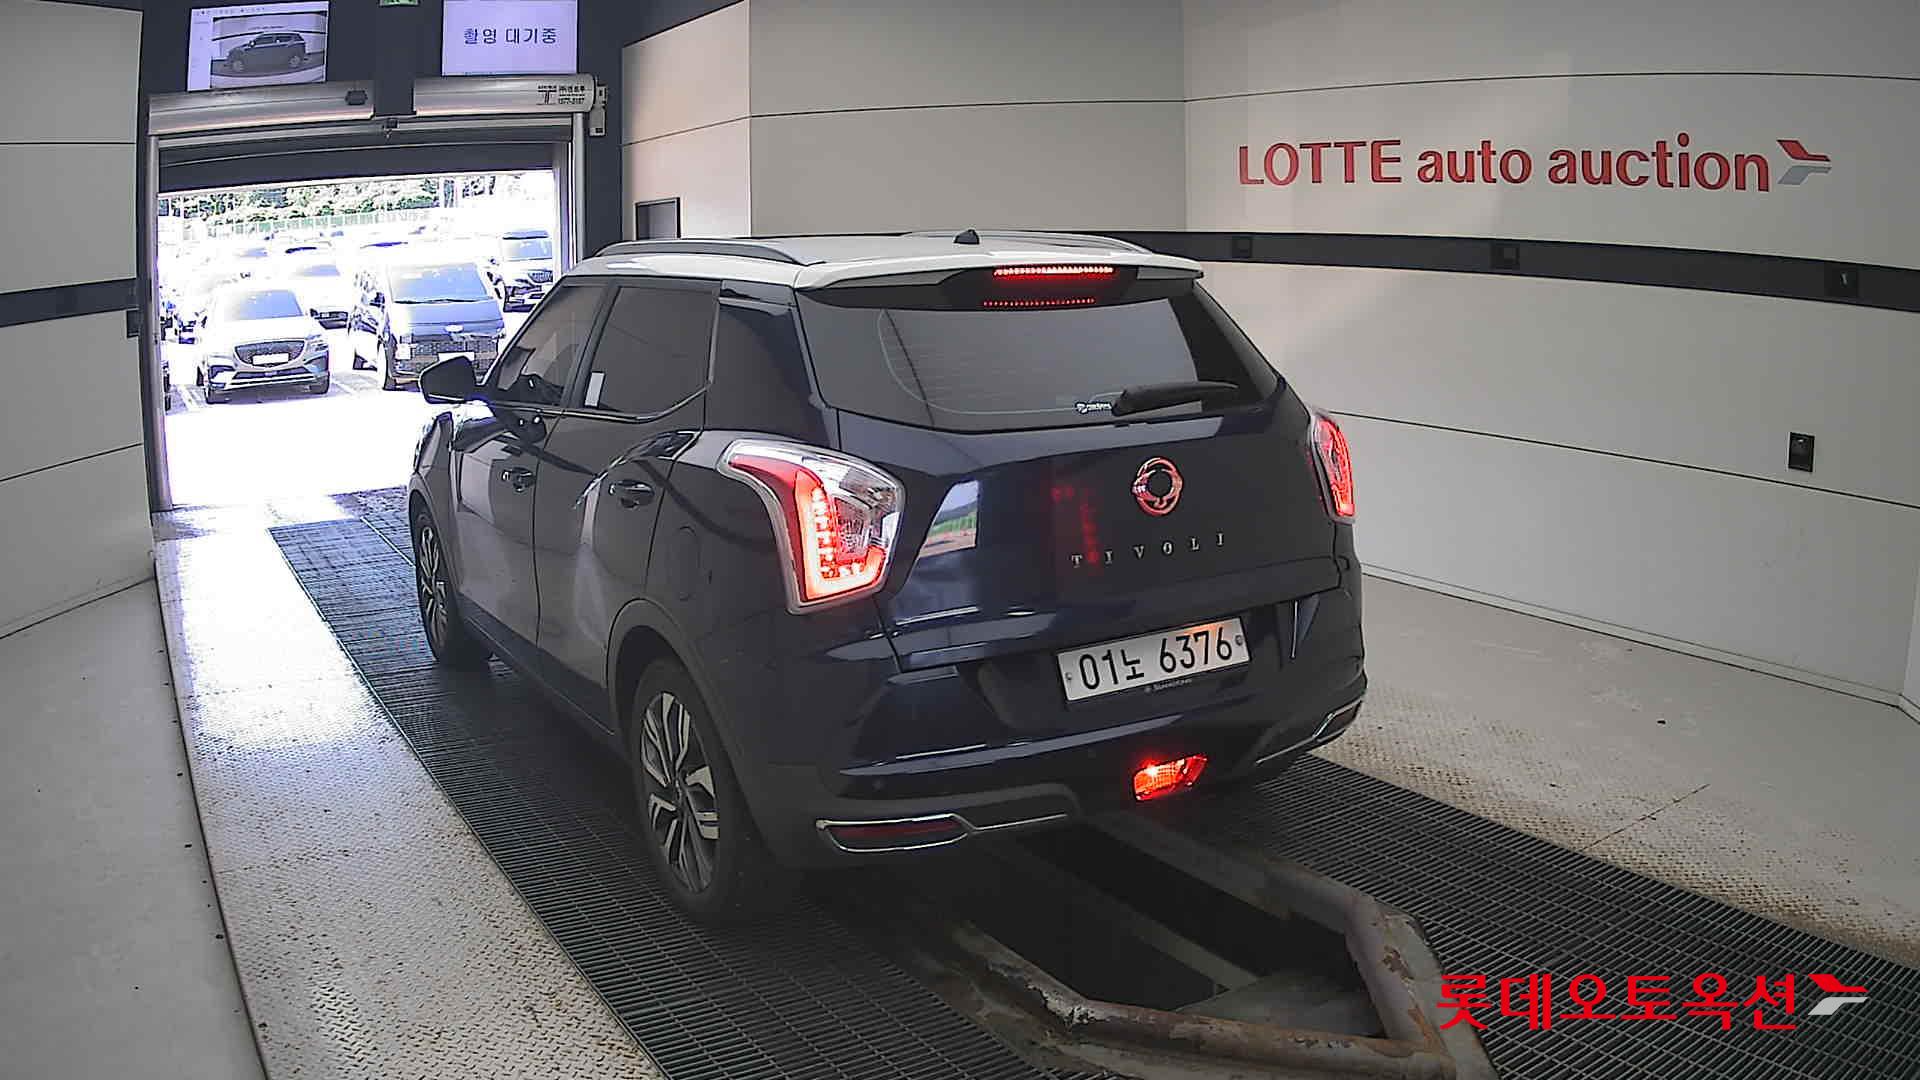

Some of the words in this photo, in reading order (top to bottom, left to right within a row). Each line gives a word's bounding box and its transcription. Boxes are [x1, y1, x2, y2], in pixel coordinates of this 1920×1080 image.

[505, 28, 557, 44] 대기중
[1239, 139, 1402, 185] LOTTE
[1417, 140, 1532, 184] auto
[1548, 132, 1769, 192] auction
[1071, 533, 1225, 568] TIVOLI
[1079, 649, 1145, 690] 01노
[1159, 627, 1233, 673] 6376
